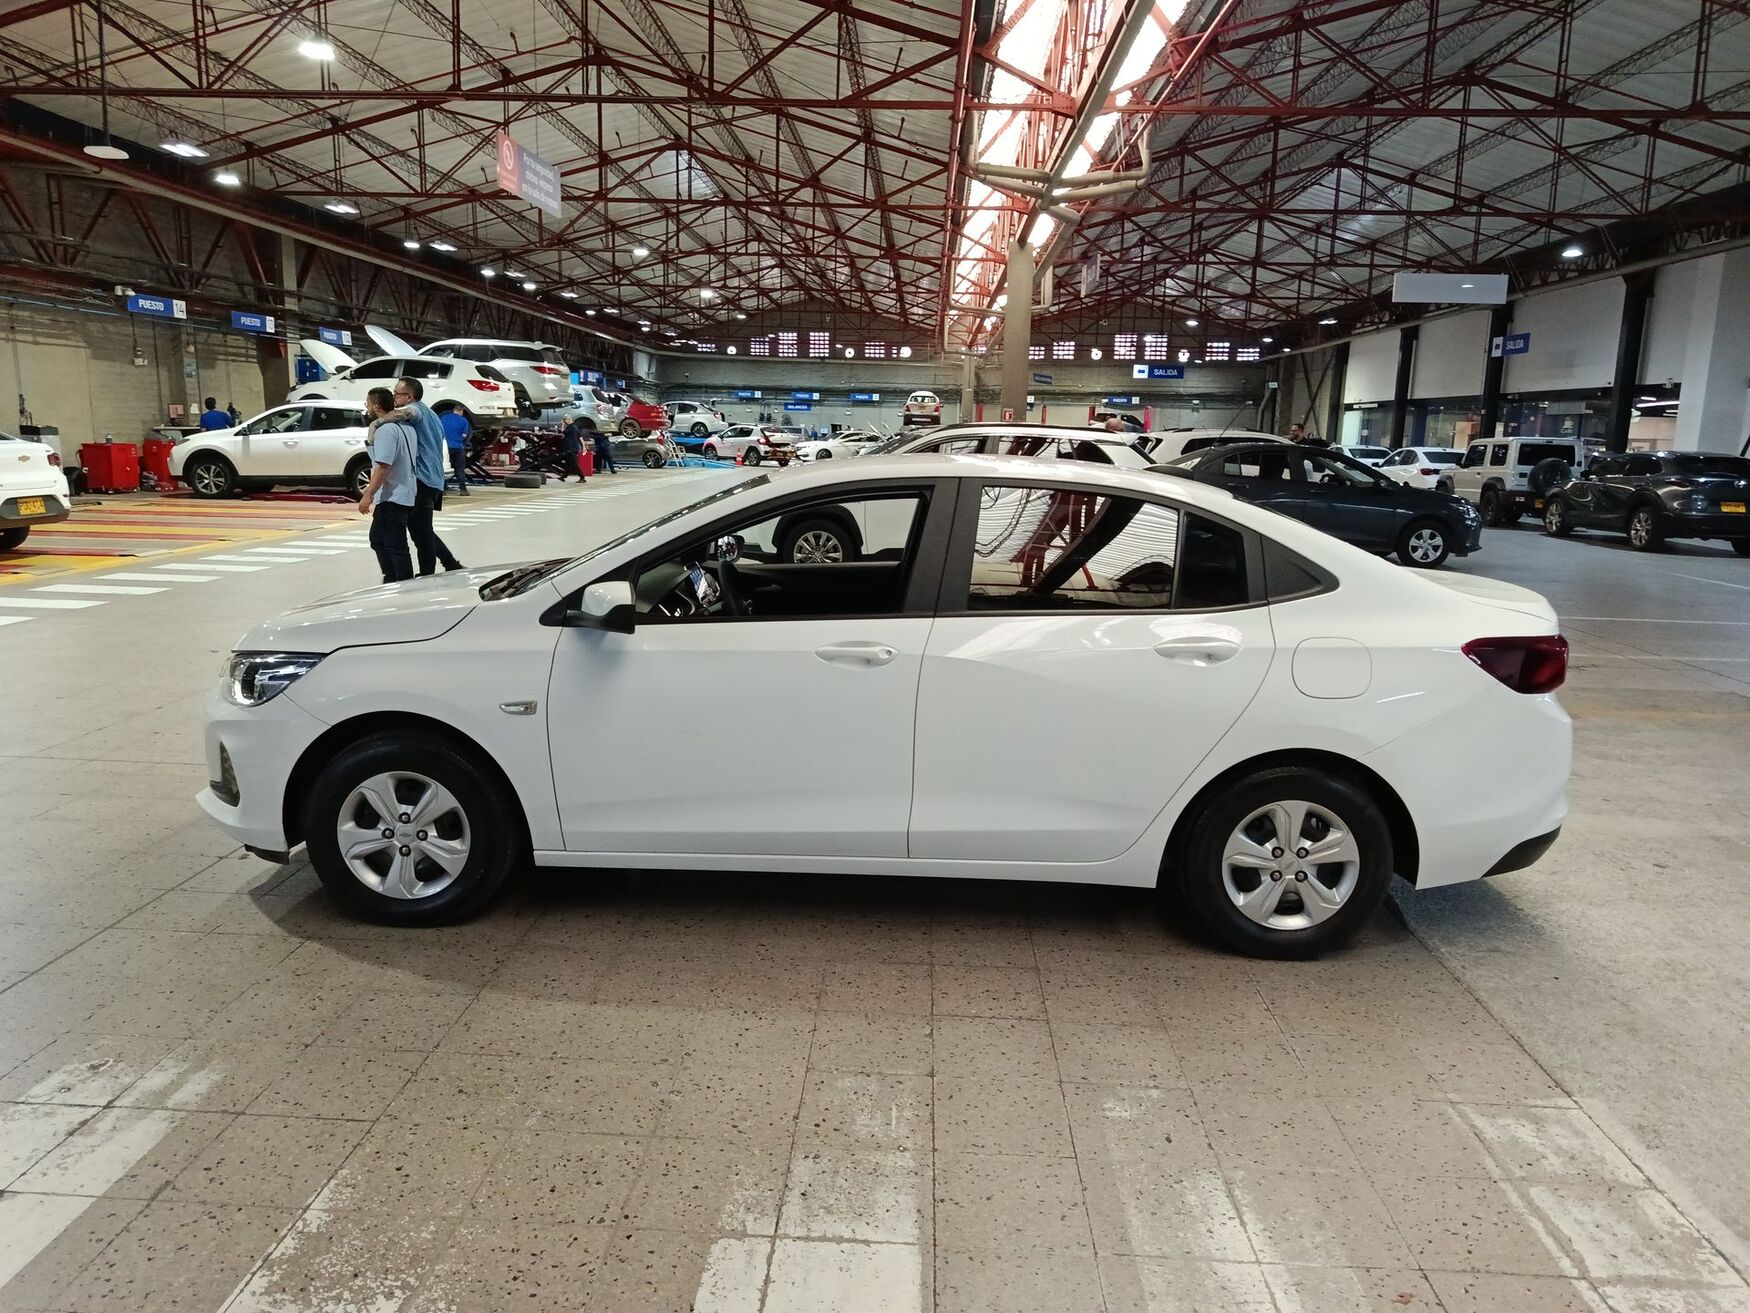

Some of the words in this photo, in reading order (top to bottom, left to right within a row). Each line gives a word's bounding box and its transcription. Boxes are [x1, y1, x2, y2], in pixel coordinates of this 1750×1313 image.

[138, 298, 164, 311] PUESTO
[174, 302, 185, 316] 14
[240, 316, 261, 327] PUESTO
[1505, 339, 1525, 350] SALIDA
[1153, 368, 1178, 376] SALIDA
